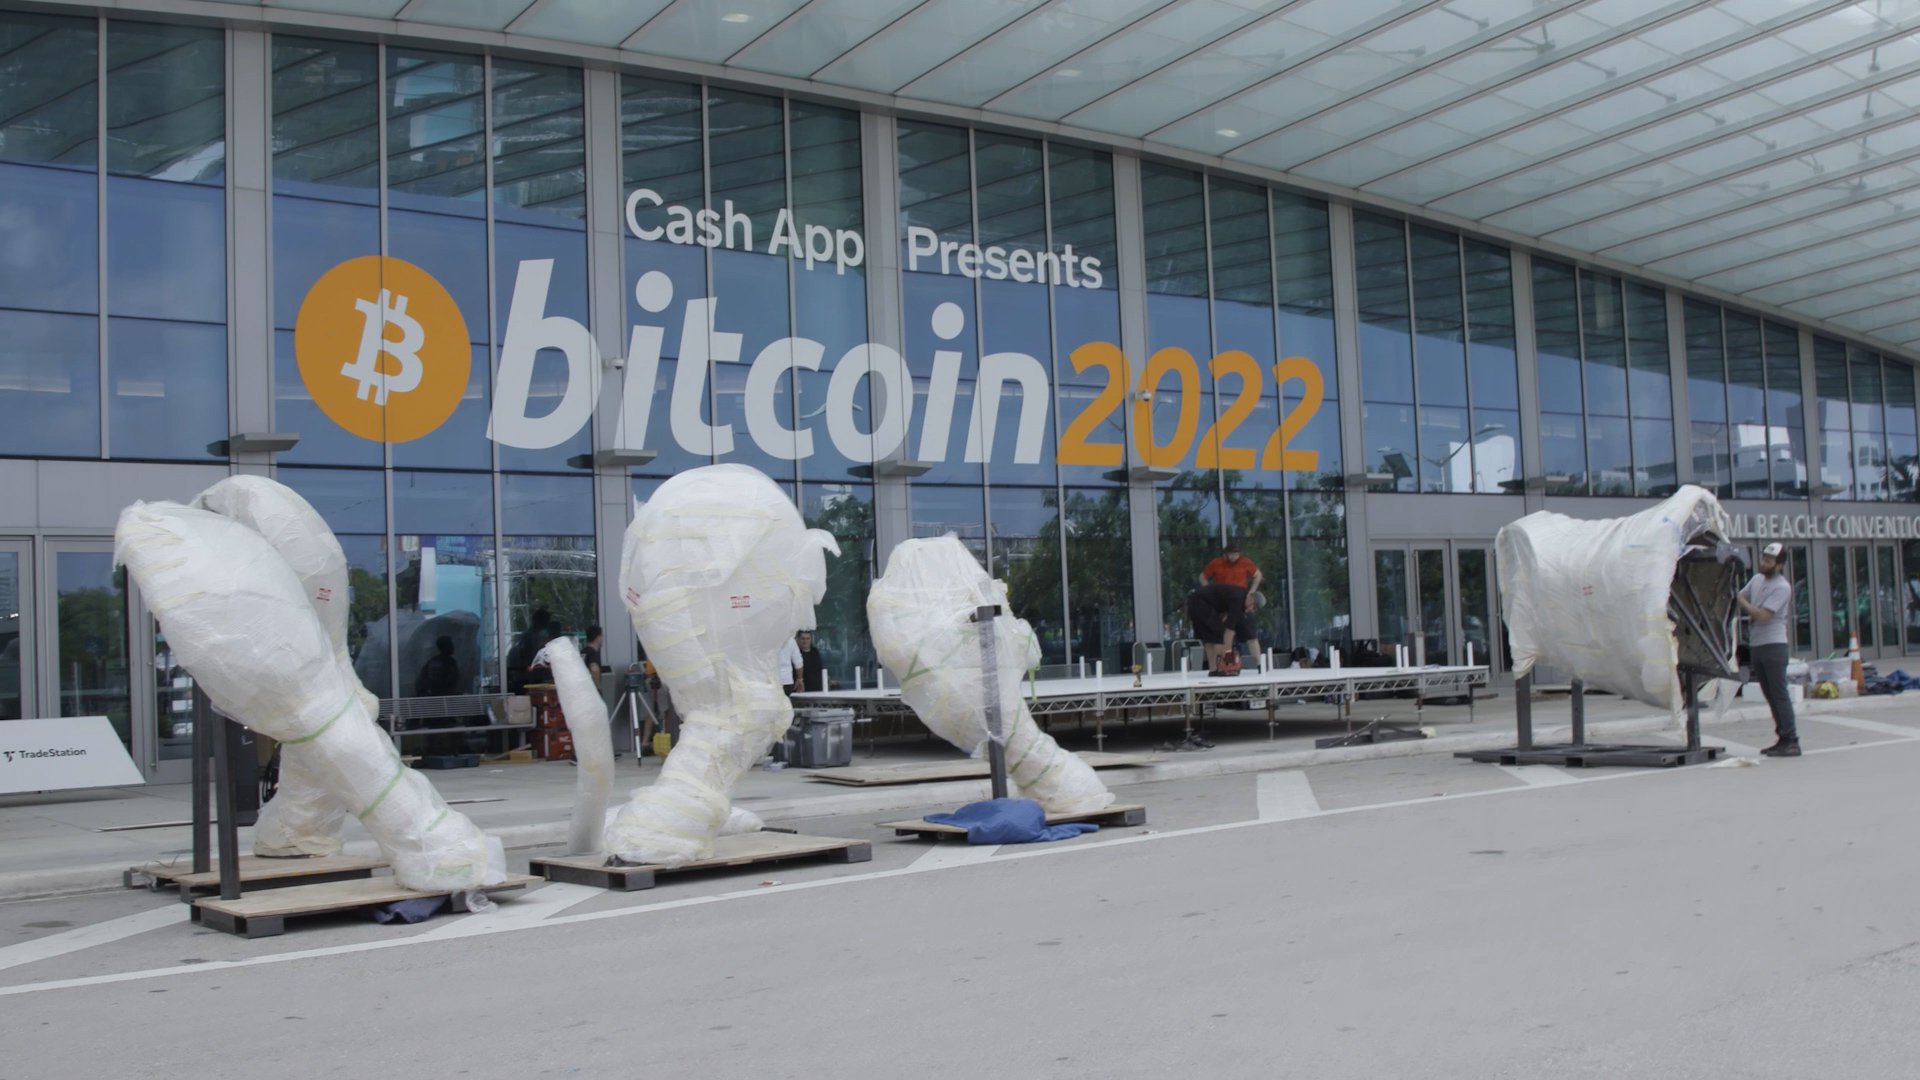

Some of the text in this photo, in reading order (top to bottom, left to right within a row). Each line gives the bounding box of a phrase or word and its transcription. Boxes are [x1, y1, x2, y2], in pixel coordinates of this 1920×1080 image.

[626, 188, 1103, 289] Cash App Presents
[1757, 513, 1819, 539] BEACH
[18, 747, 87, 759] TradeStation
